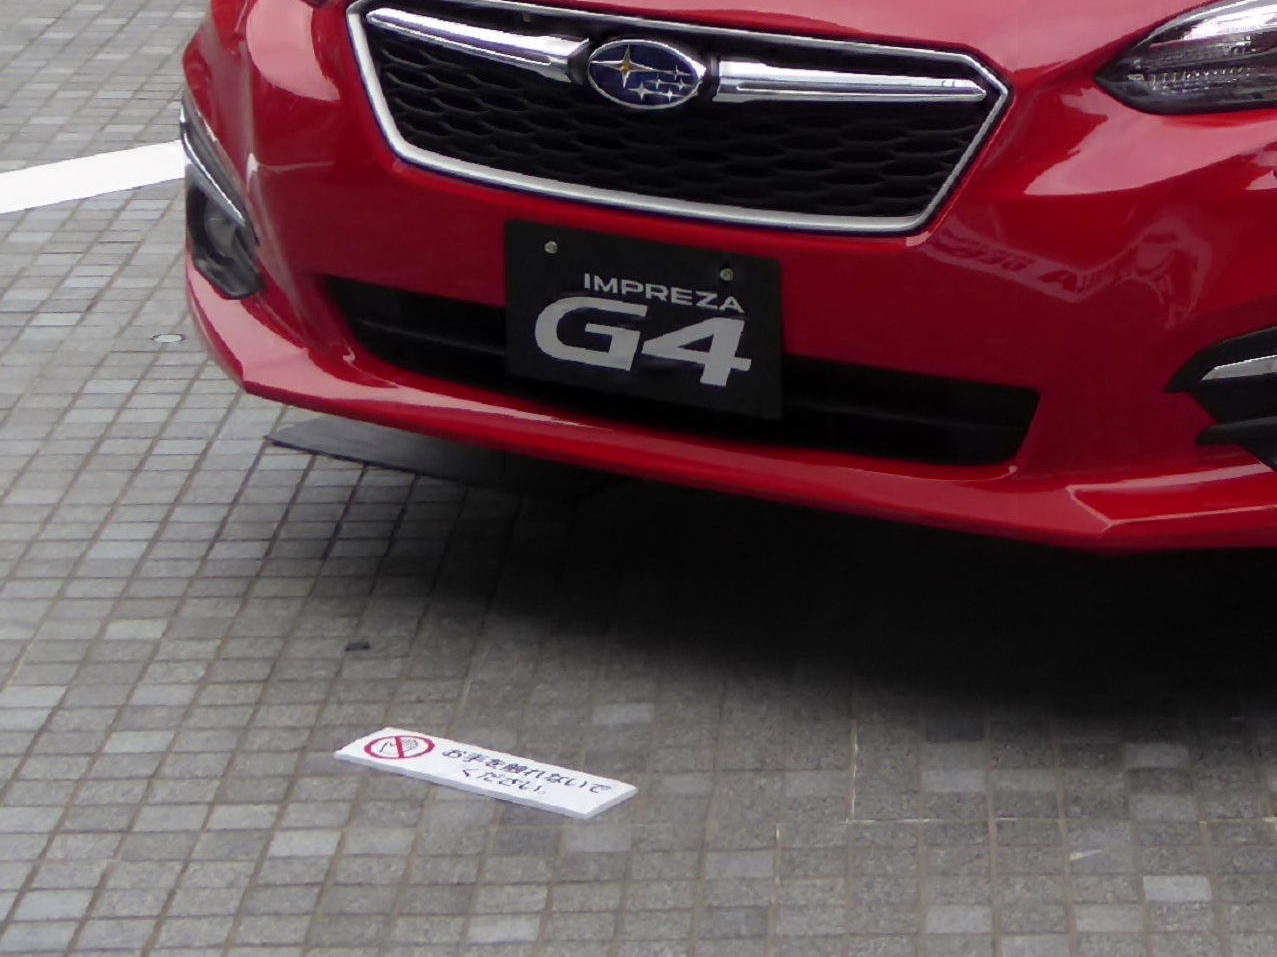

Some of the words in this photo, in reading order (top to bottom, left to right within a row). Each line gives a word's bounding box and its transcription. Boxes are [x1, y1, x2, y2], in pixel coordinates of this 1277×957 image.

[583, 272, 745, 314] IMPREZA
[534, 295, 752, 388] G4
[442, 747, 613, 794] お手を触れないで
